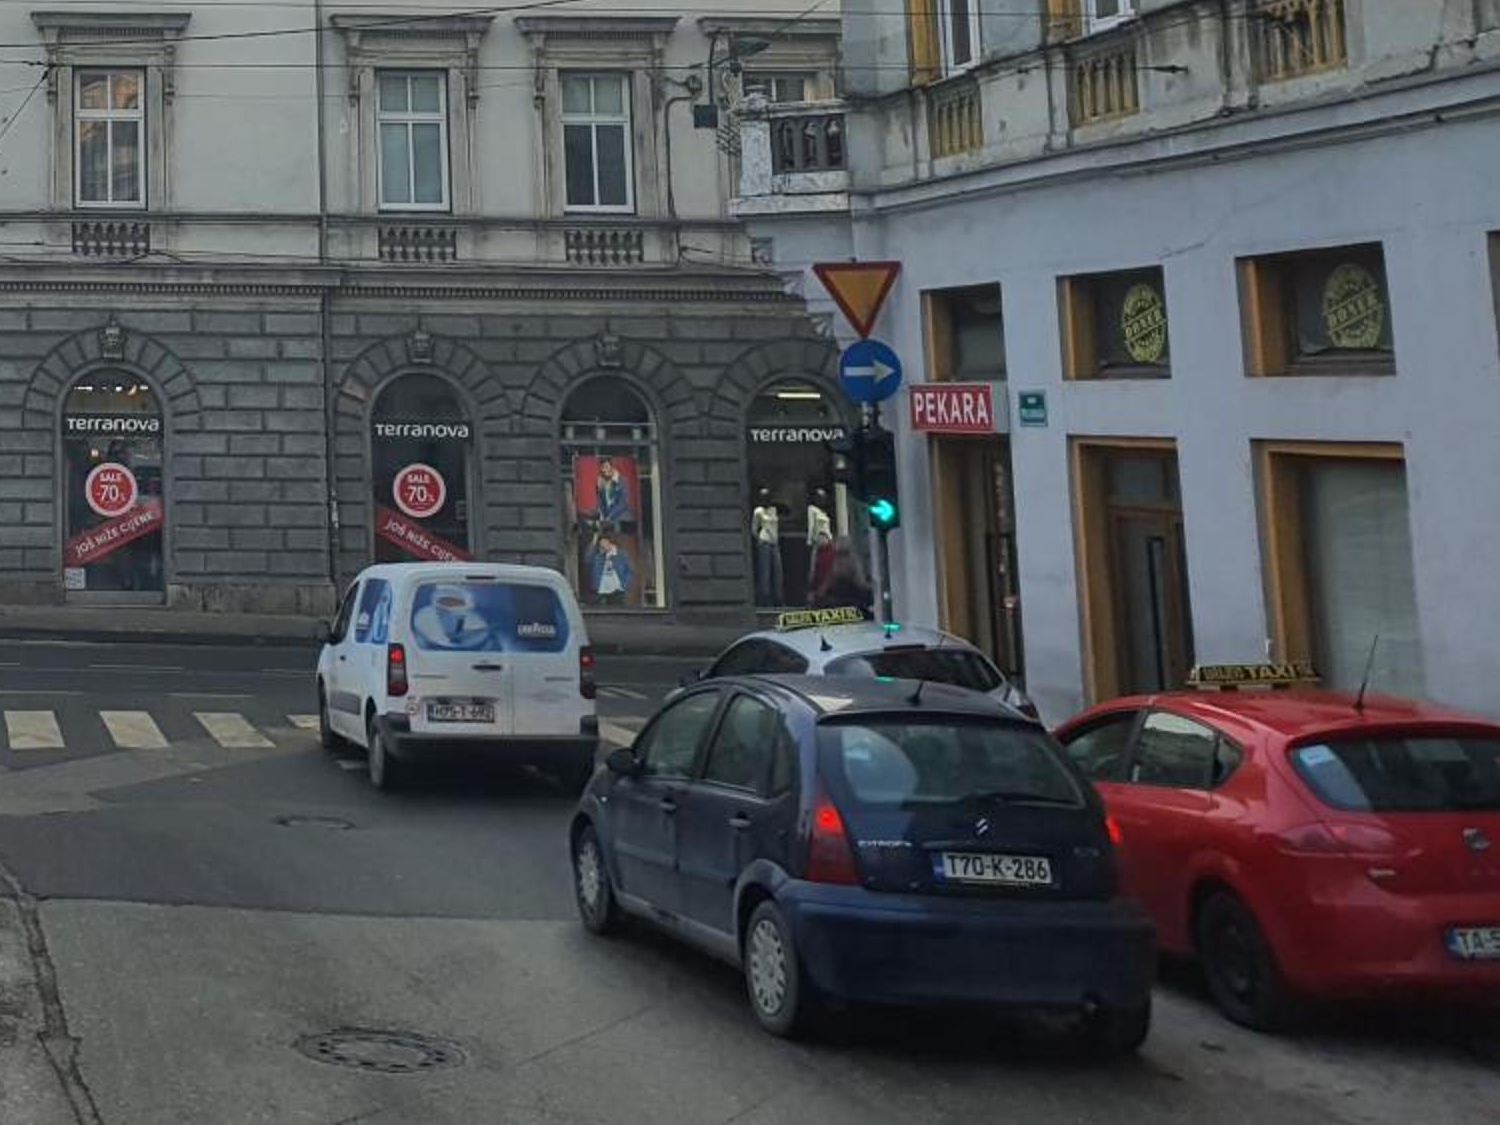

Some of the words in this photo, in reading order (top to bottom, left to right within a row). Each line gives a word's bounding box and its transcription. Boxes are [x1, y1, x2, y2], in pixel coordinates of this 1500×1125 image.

[913, 392, 989, 424] PEKARA
[1249, 666, 1298, 679] TAXI
[947, 855, 1048, 879] T70-K-286
